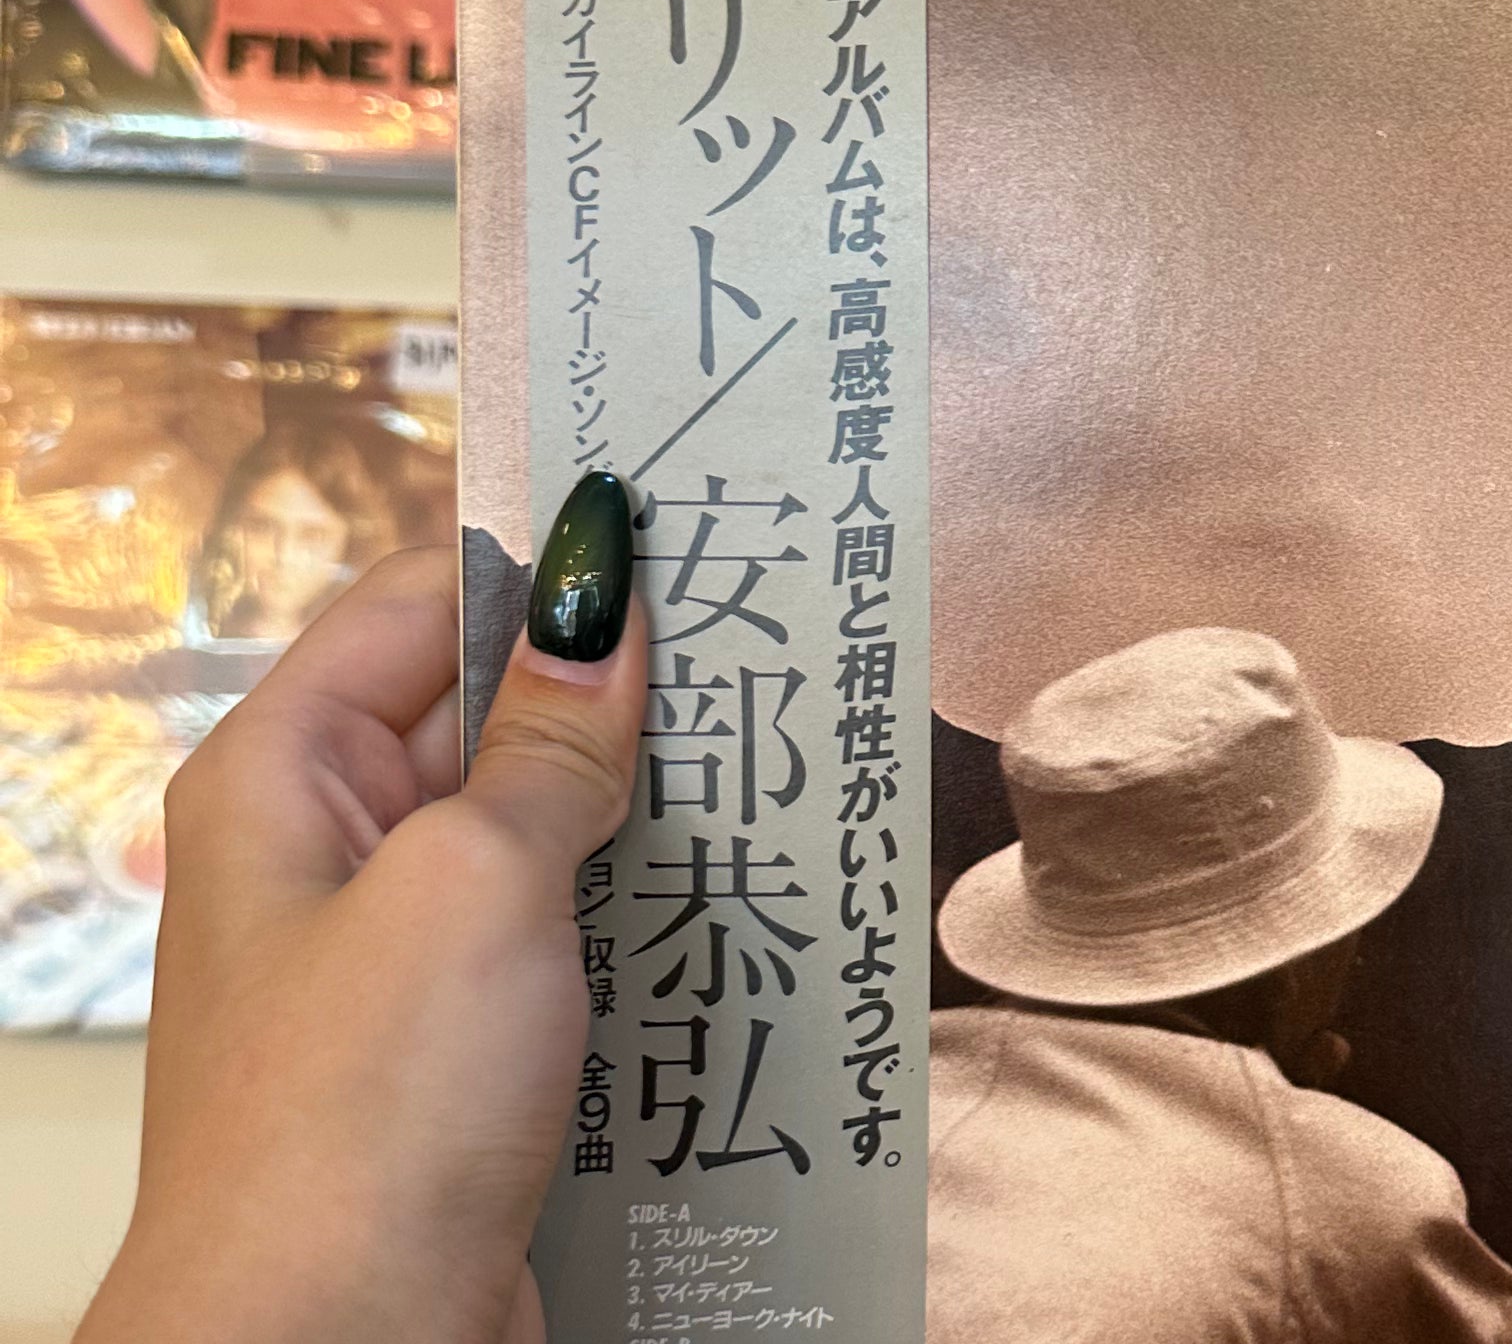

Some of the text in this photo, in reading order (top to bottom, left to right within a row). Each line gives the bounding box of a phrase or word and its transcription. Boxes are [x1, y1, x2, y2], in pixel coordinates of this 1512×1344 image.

[225, 28, 457, 87] FINE L
[628, 1203, 691, 1224] SIDE-A
[653, 1225, 779, 1249] スリル・ダウン
[653, 1254, 750, 1276] アイリーン
[653, 1281, 773, 1304] マイ・ディアー
[652, 1306, 834, 1331] ニューヨーク・ナイト
